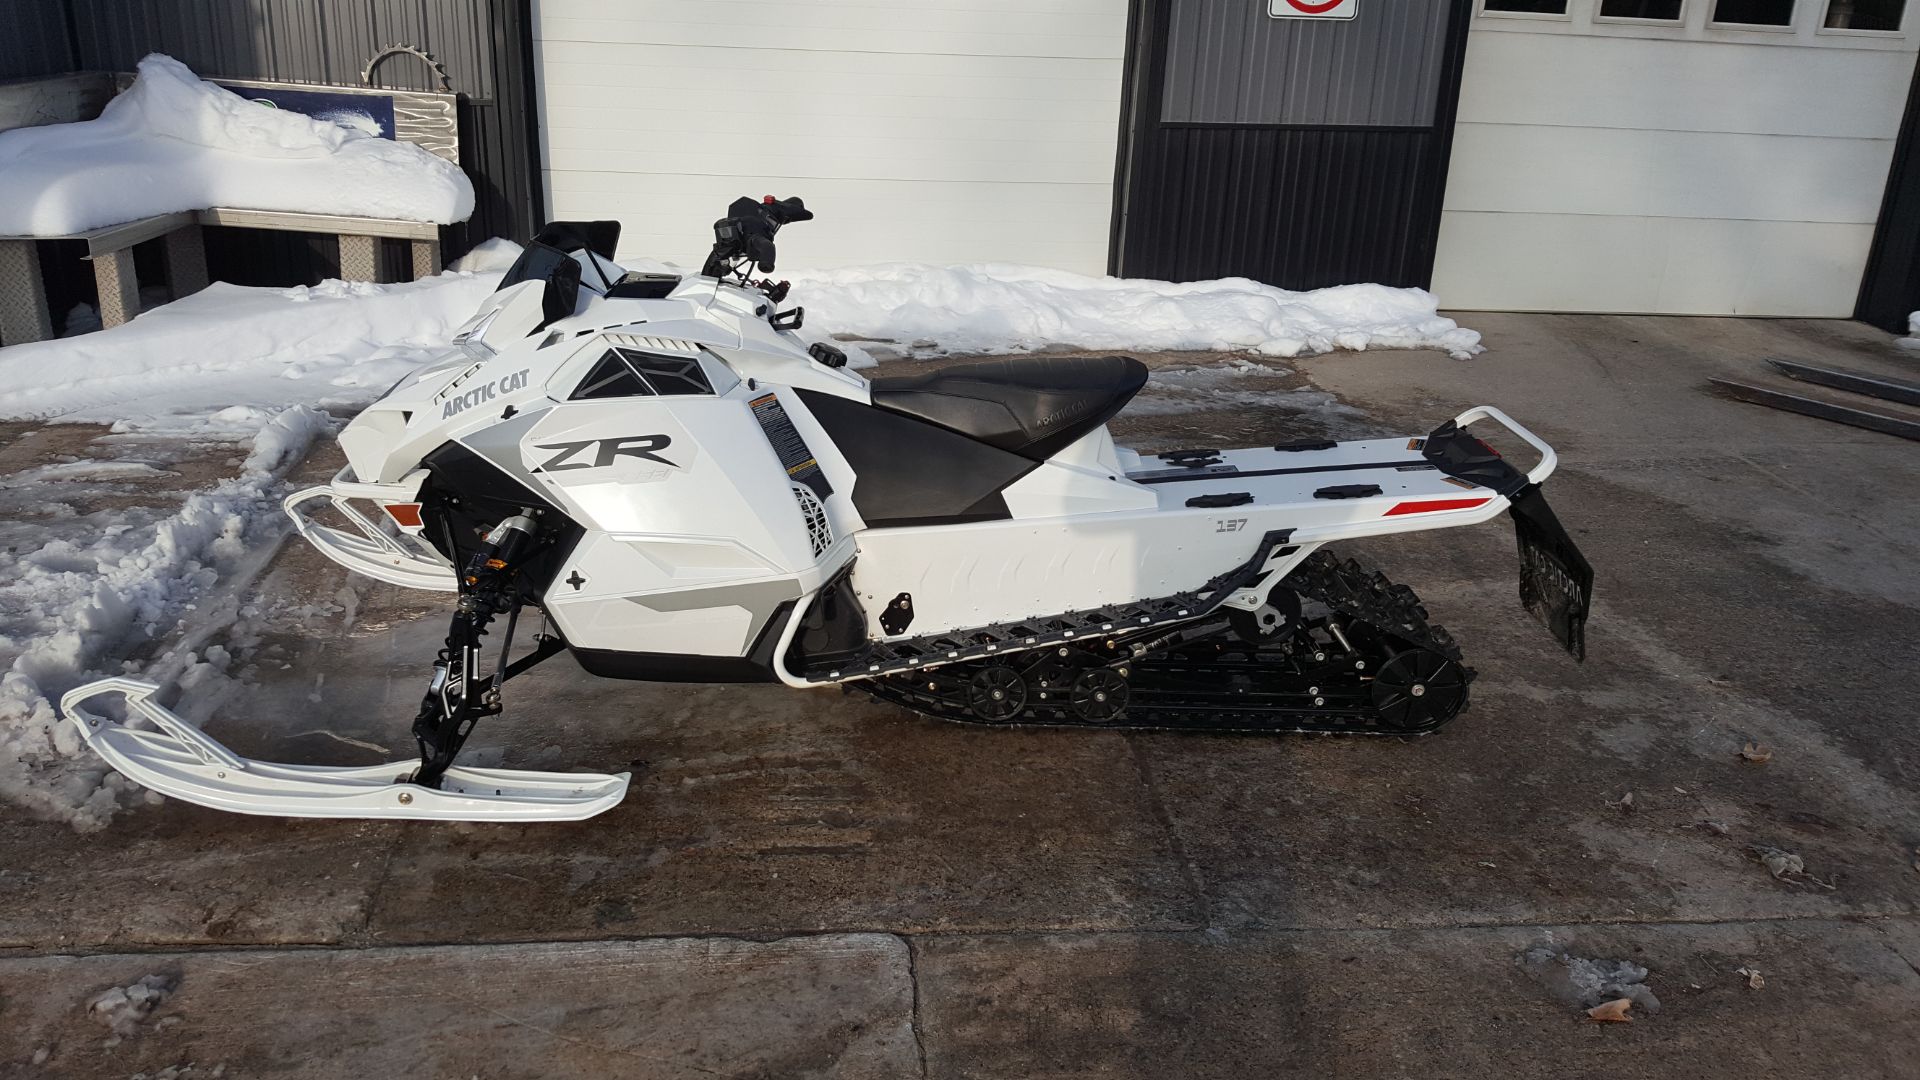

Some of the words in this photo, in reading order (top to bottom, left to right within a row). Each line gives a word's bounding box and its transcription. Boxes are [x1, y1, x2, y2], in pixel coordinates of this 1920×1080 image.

[441, 380, 497, 421] ARCTIC
[499, 367, 531, 395] CAT
[529, 433, 681, 475] ZR
[1216, 518, 1249, 533] 137
